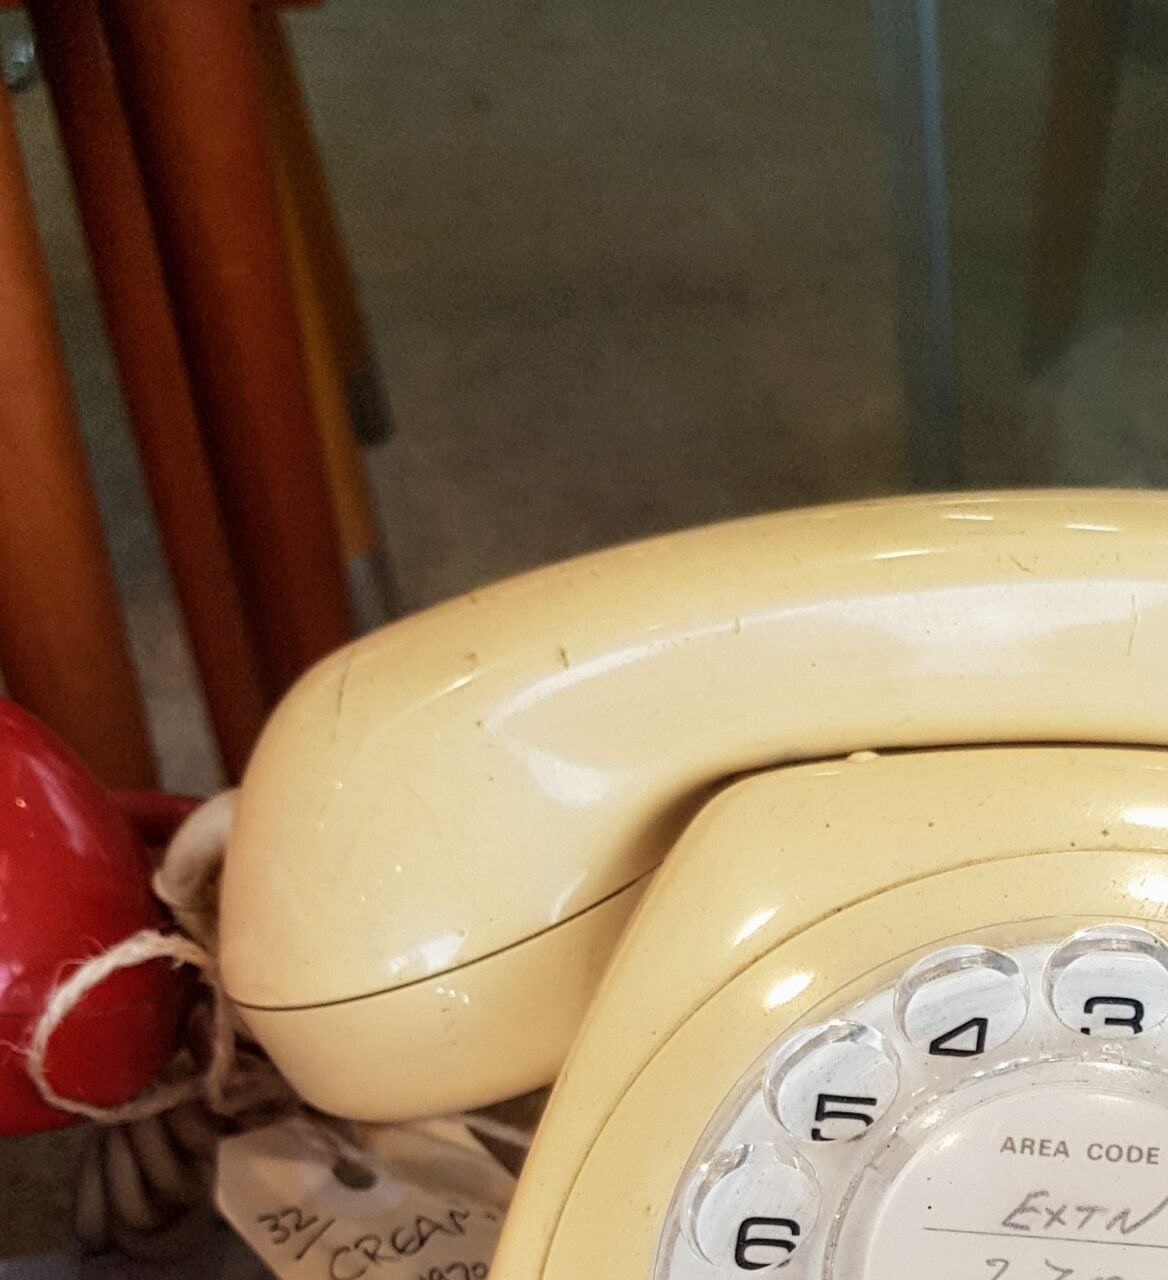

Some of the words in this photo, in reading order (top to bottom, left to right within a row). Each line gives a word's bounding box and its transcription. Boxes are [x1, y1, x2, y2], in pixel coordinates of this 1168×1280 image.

[1080, 996, 1144, 1036] 3
[928, 1017, 988, 1057] 4
[811, 1093, 877, 1142] 5
[1000, 1136, 1070, 1159] AREA
[1086, 1143, 1161, 1166] CODE
[734, 1215, 801, 1271] 6
